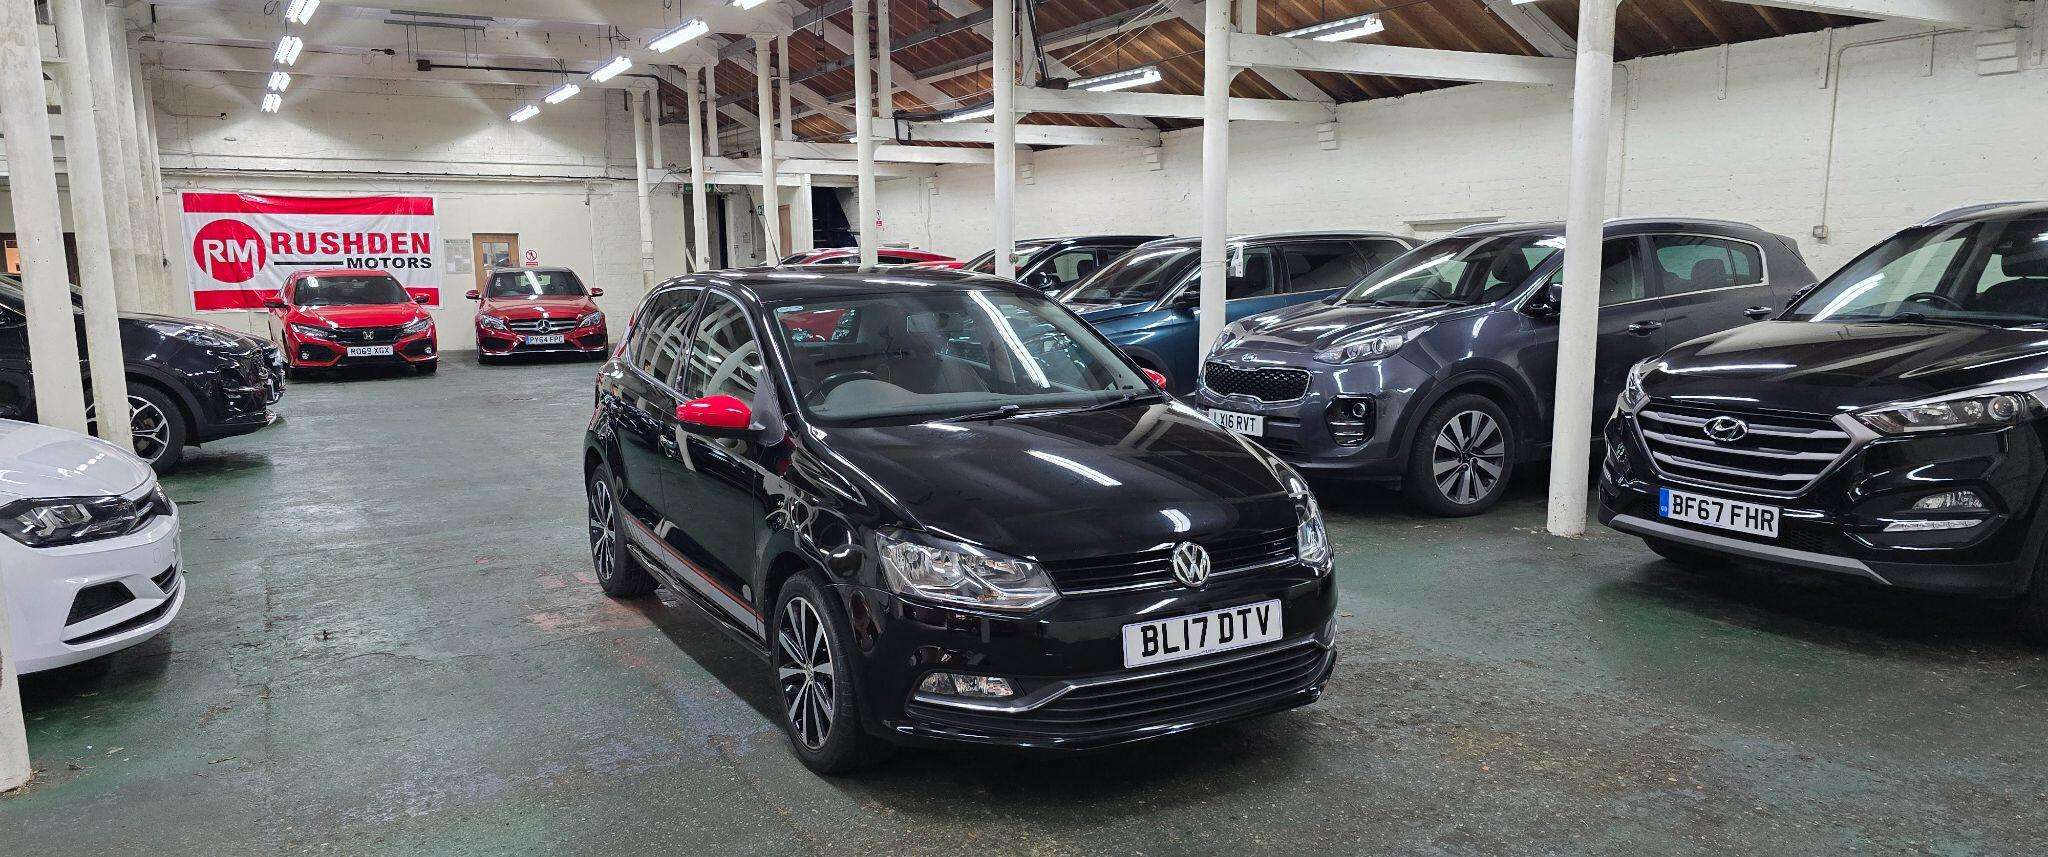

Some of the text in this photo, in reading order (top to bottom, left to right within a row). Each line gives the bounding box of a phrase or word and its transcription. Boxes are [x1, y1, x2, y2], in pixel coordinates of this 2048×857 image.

[202, 239, 263, 278] RM
[269, 231, 431, 255] RUSHDEN
[346, 257, 432, 270] MOTORS
[1236, 415, 1256, 432] RVT
[1672, 494, 1774, 532] BF67 FHR
[1140, 604, 1270, 658] BL17 DTV
